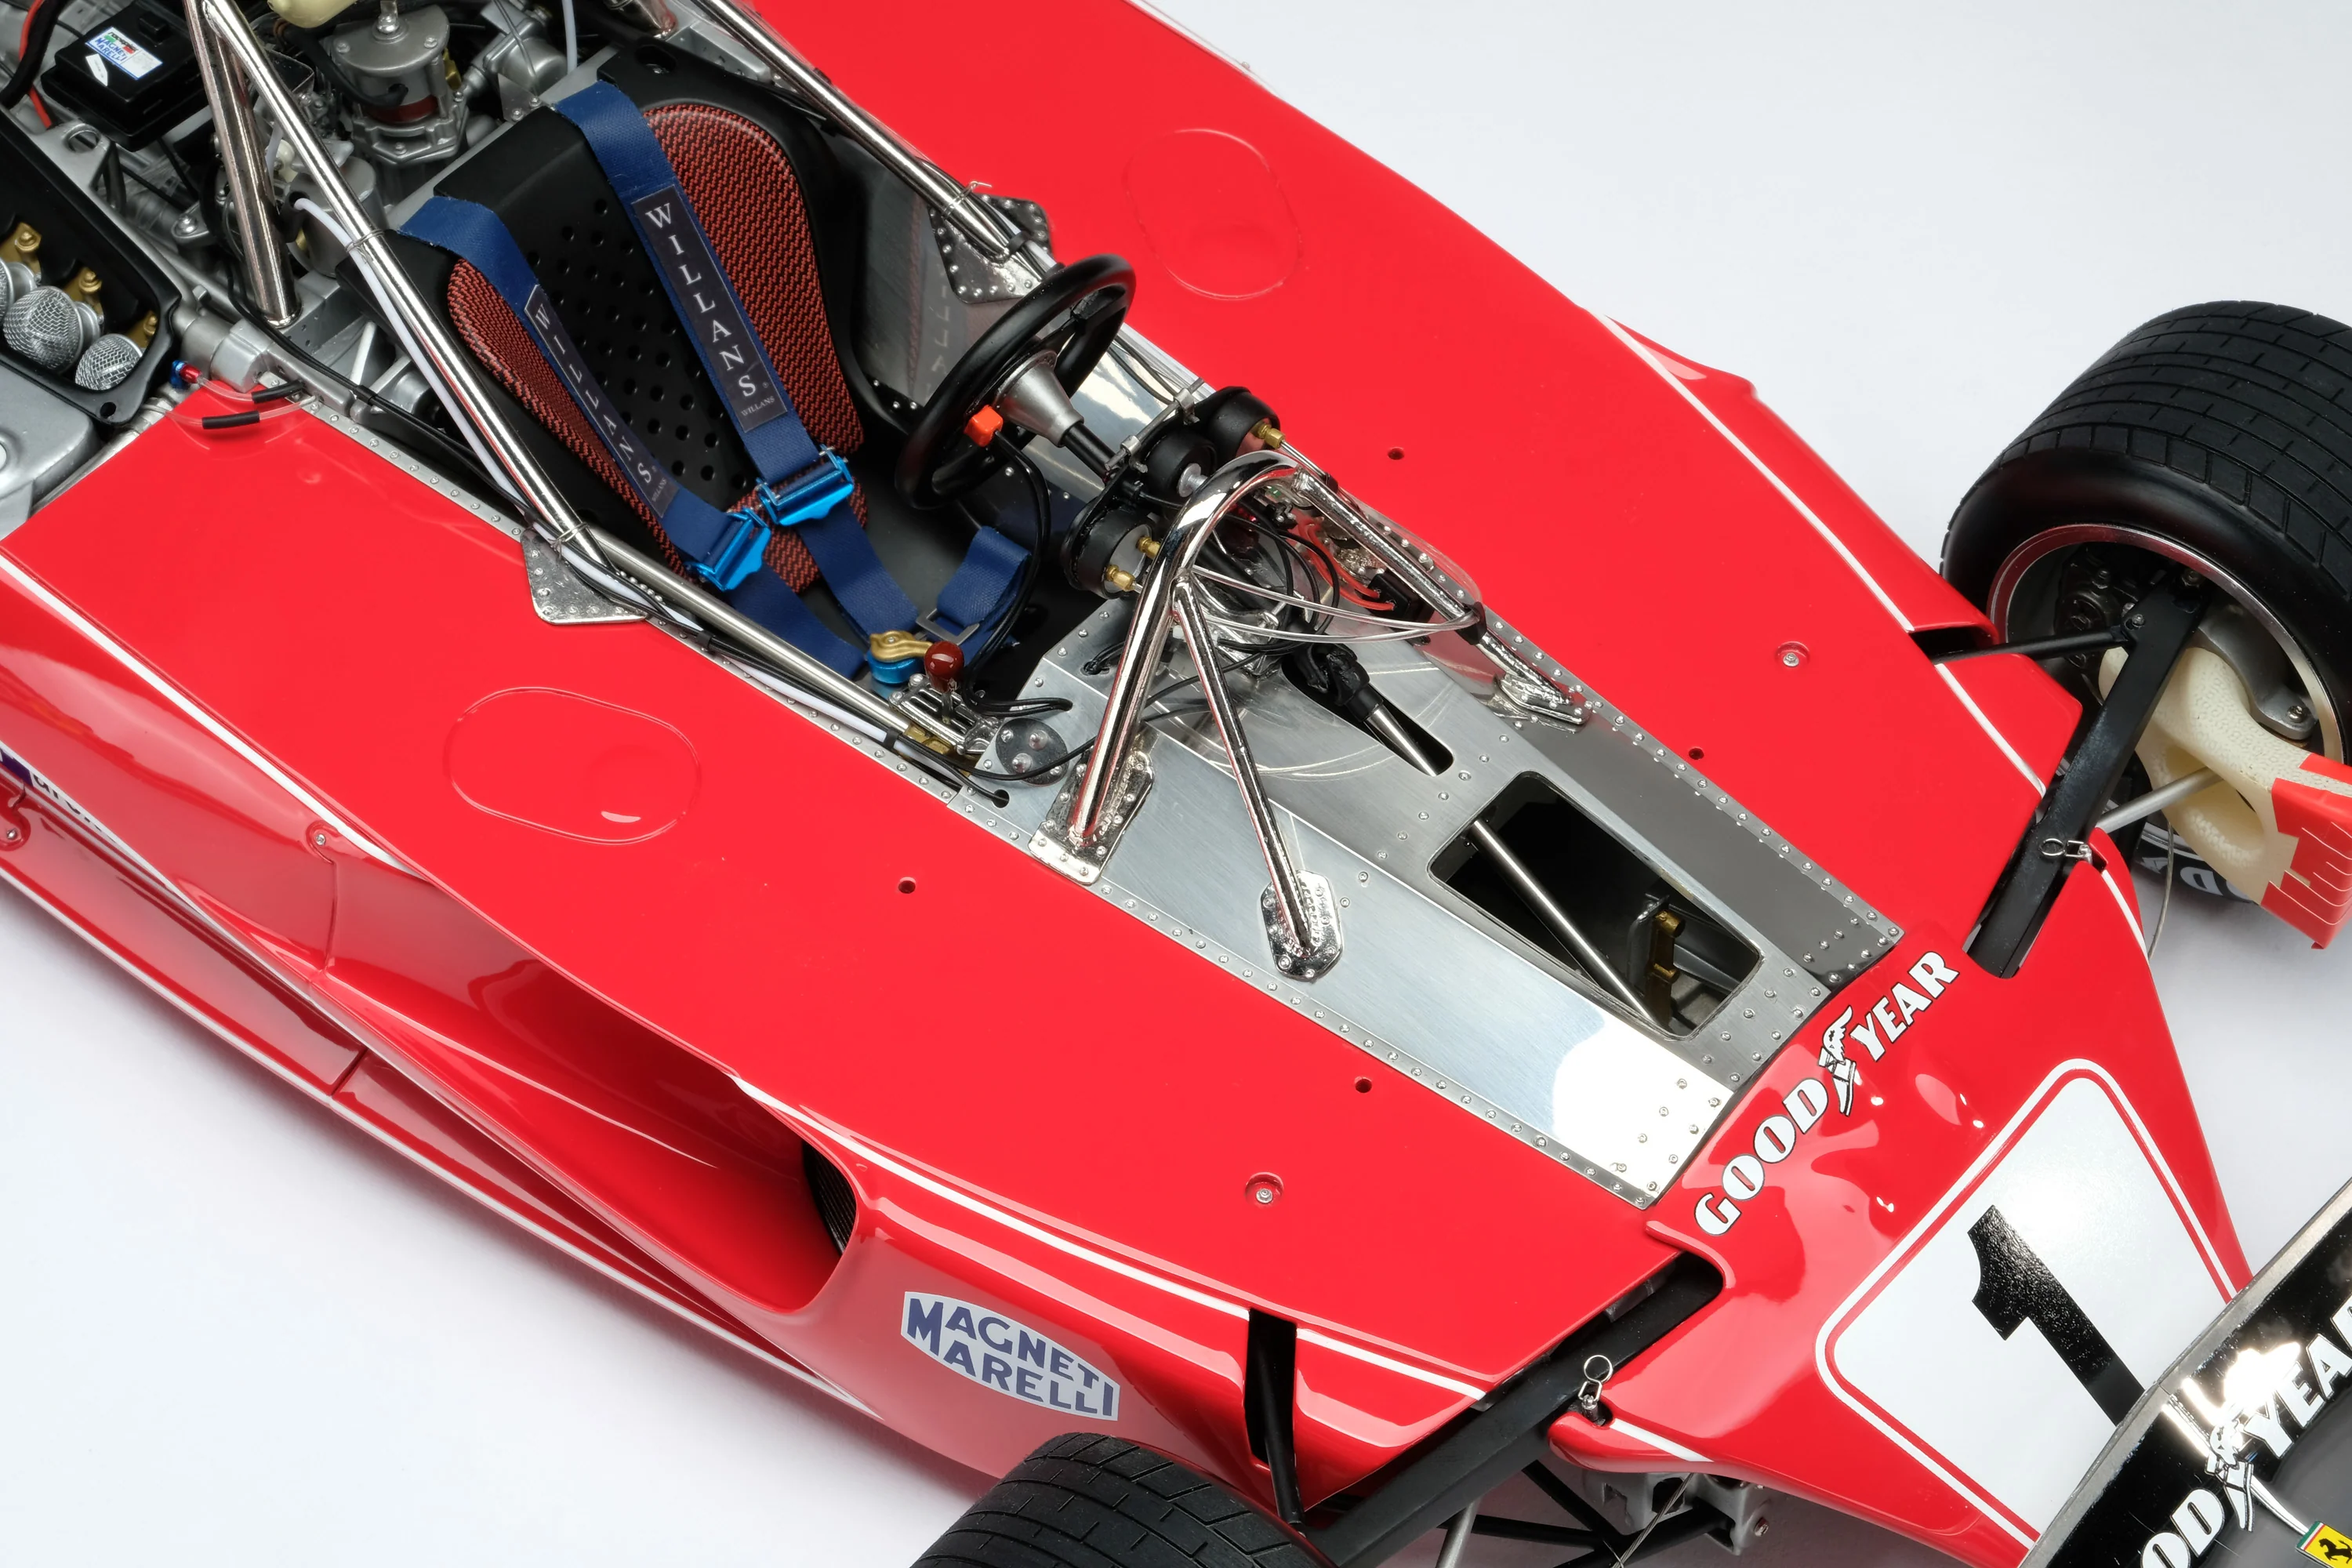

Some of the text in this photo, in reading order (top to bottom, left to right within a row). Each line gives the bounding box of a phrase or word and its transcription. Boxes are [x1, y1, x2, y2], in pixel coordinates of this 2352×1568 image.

[95, 38, 127, 59] MAGNETI
[95, 39, 127, 61] MARELLI
[645, 203, 756, 397] WILLANS
[535, 303, 651, 483] WILLANS
[741, 395, 775, 416] WILLANS
[1694, 951, 1960, 1236] GOOD YEAR
[907, 1298, 1113, 1410] MAGNETI
[907, 1303, 1113, 1416] MARELLI
[1968, 1205, 2145, 1427] 1
[2141, 1489, 2225, 1568] OD
